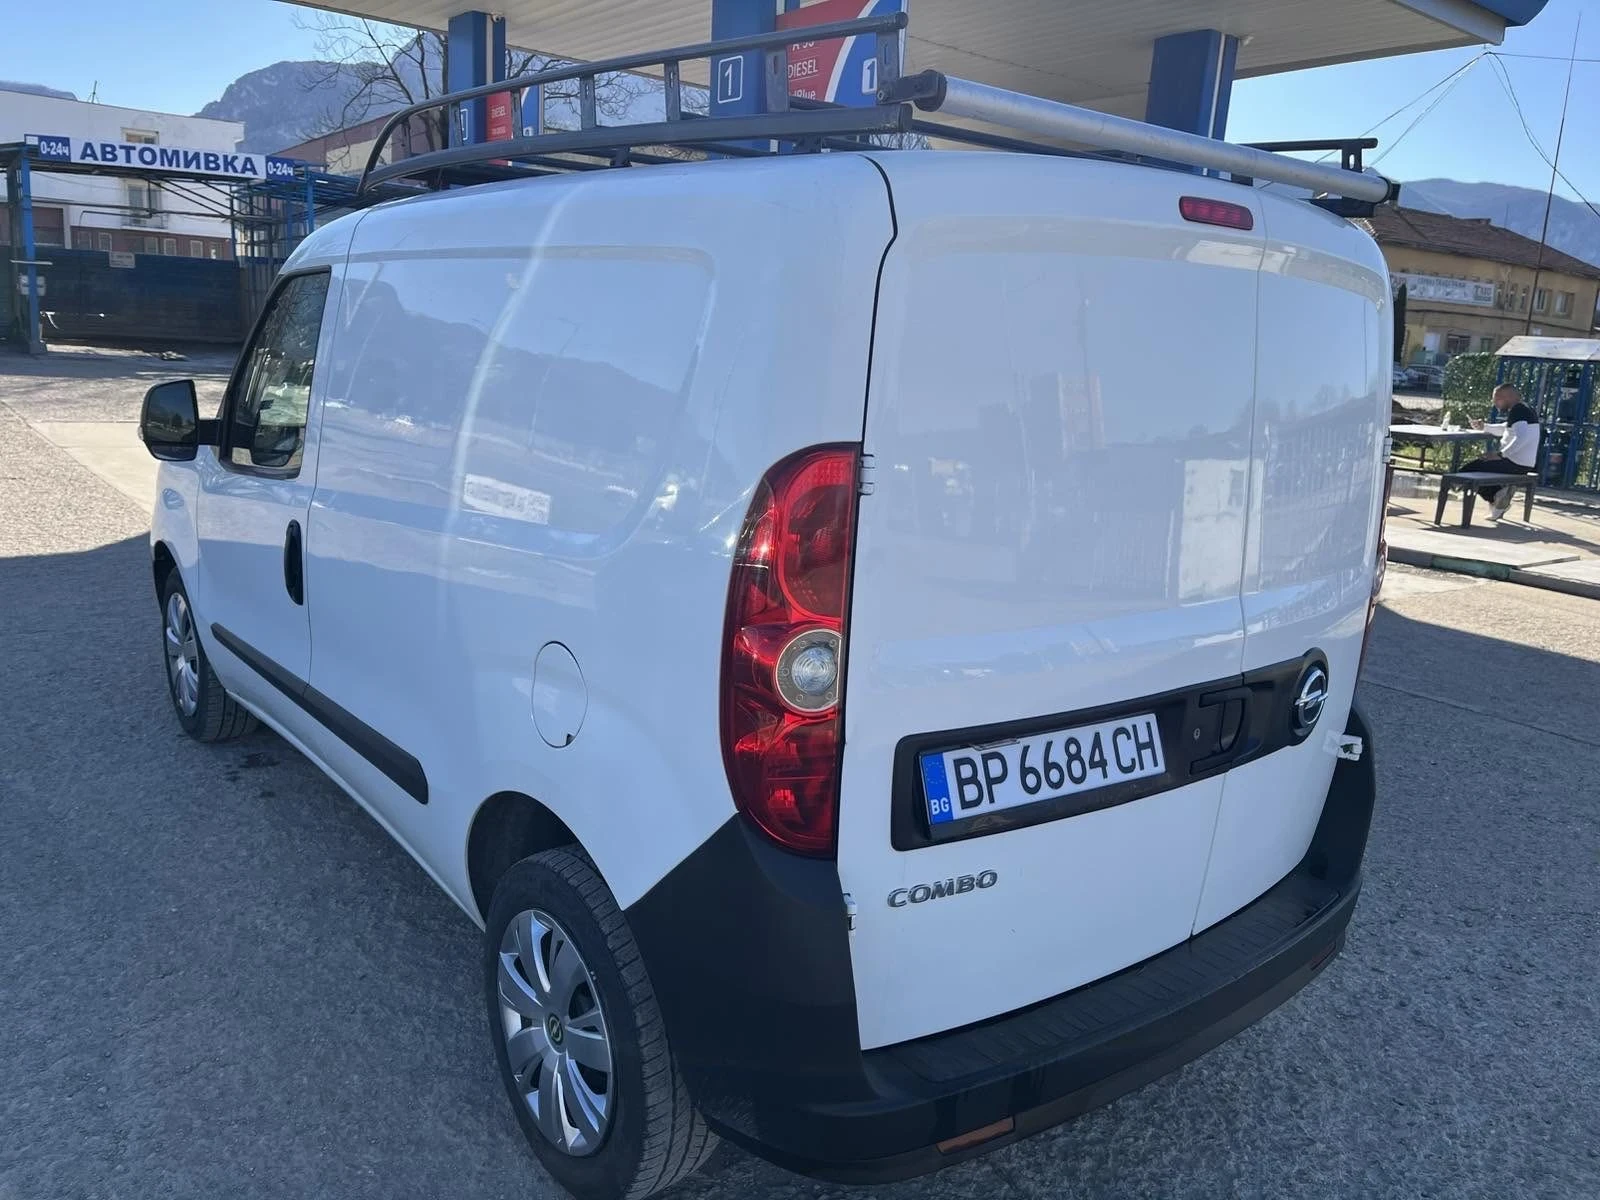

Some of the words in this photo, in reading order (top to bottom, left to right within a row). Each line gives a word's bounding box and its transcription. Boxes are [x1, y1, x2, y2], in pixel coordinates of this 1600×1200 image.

[724, 64, 733, 96] 1
[787, 58, 818, 79] DIESEL
[866, 61, 876, 90] 1
[79, 141, 258, 176] АВТОМИВКА
[952, 752, 1008, 811] BP
[1018, 731, 1109, 796] 6684
[1110, 720, 1160, 775] CH
[930, 798, 950, 816] BG
[886, 869, 999, 908] COMBO
